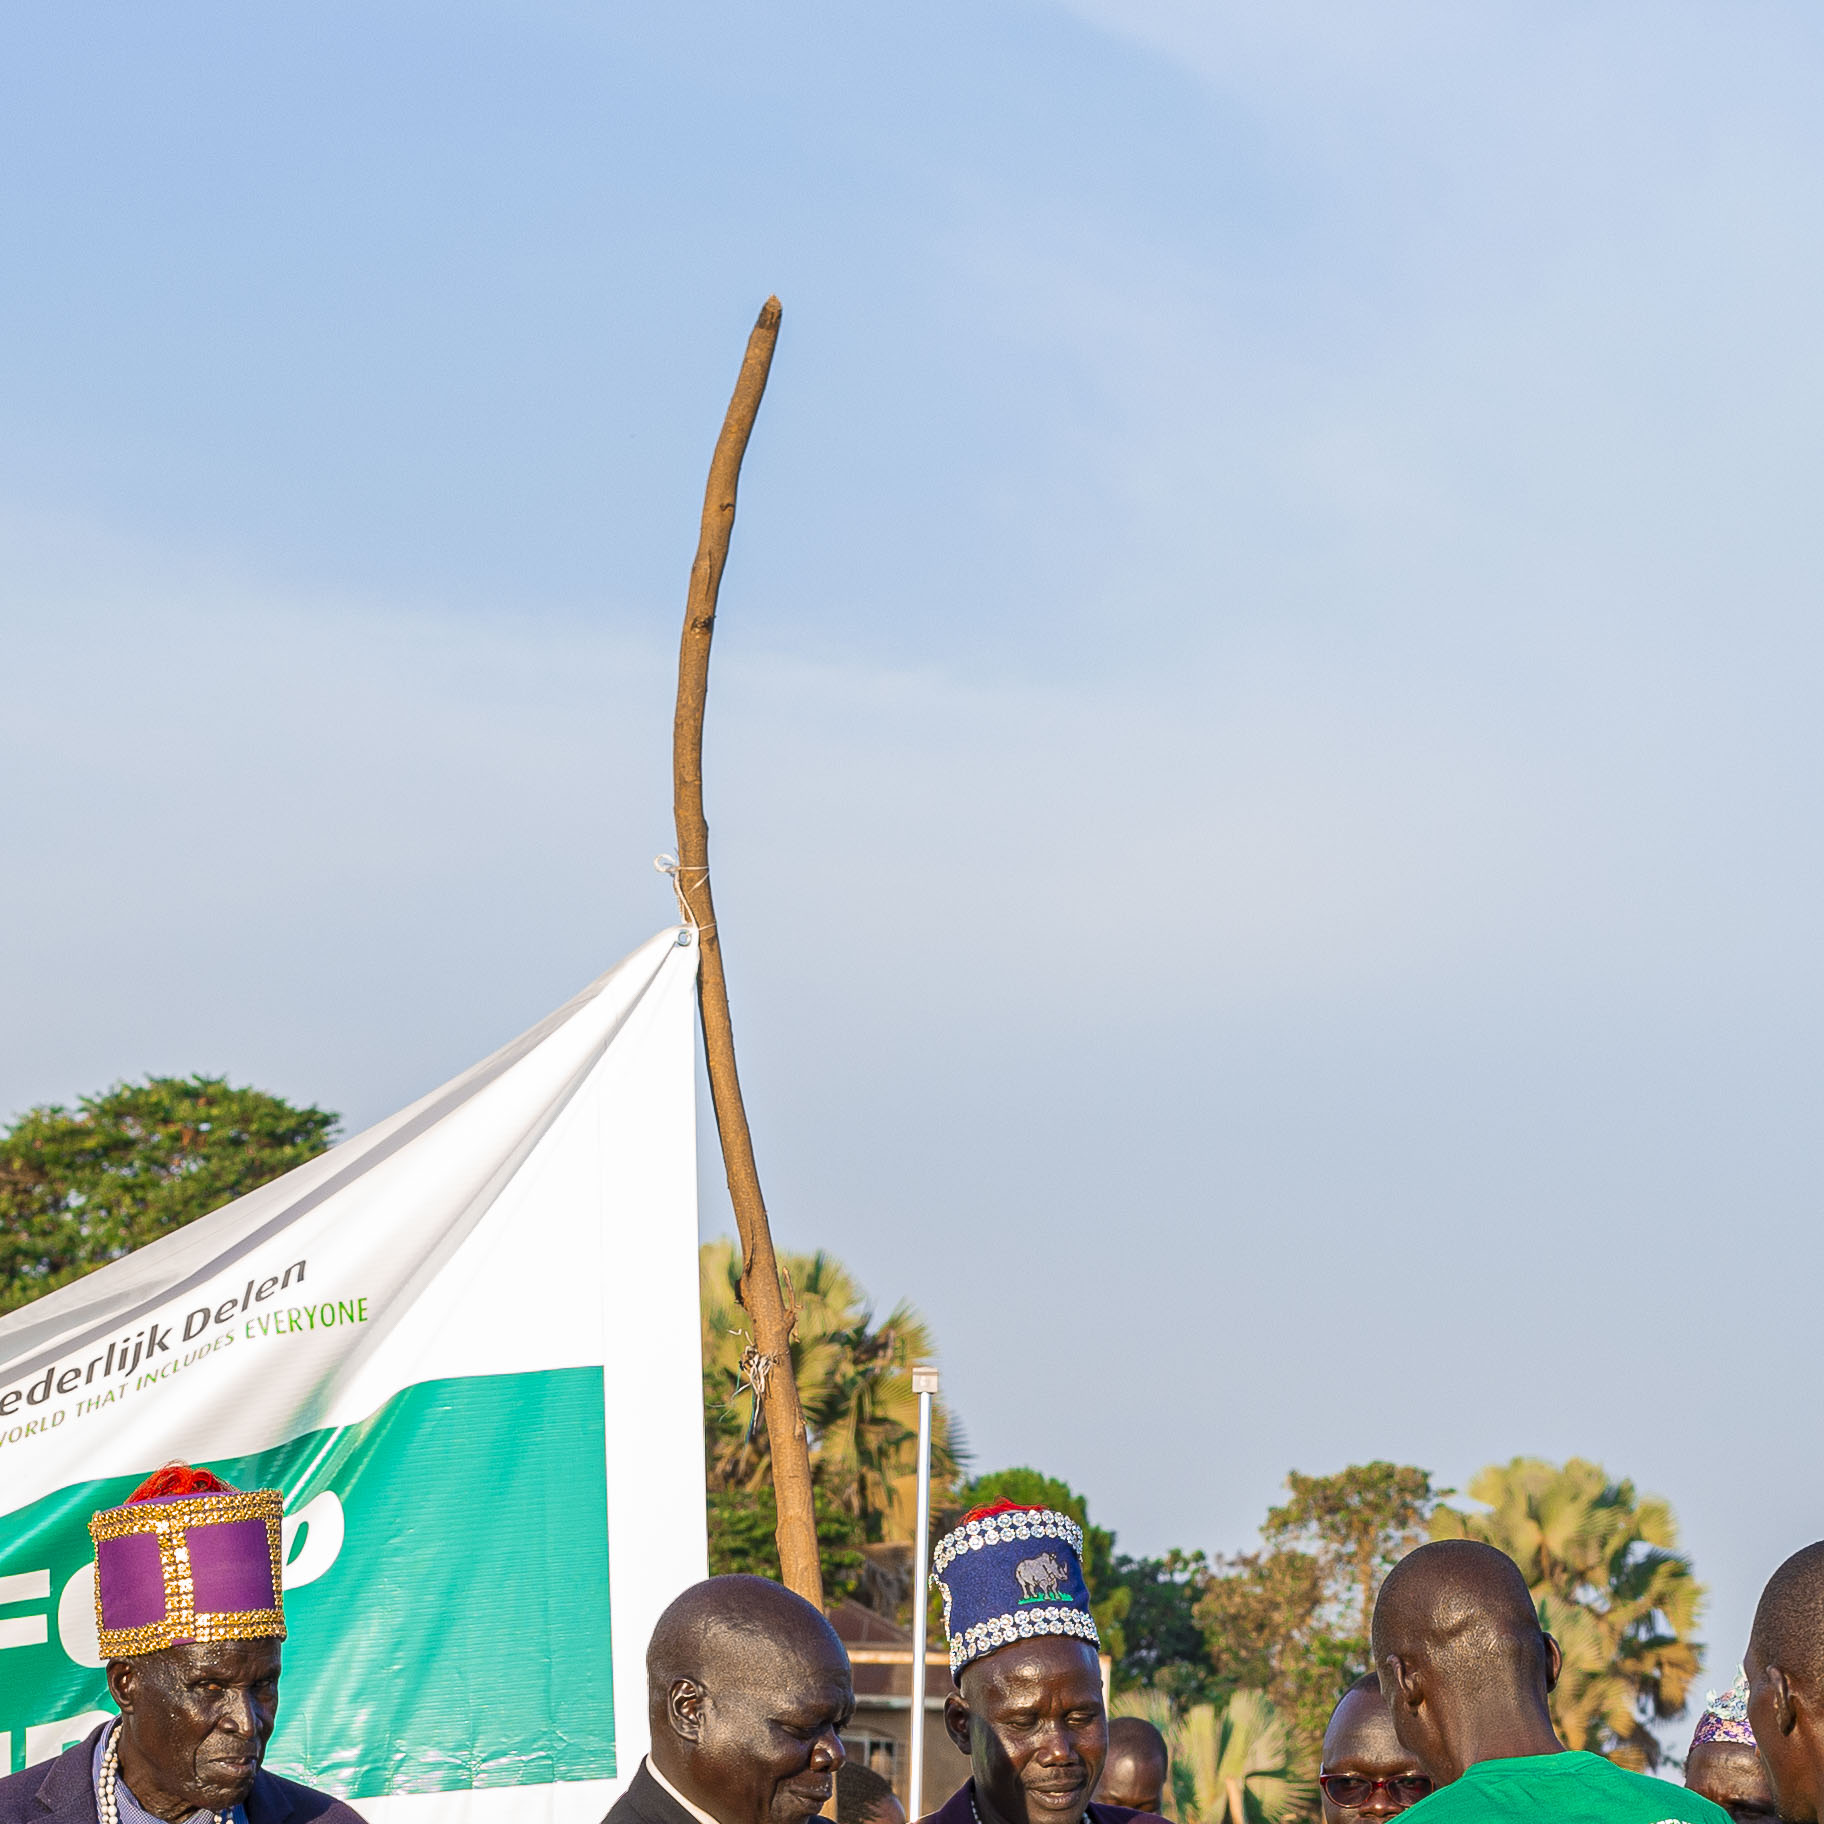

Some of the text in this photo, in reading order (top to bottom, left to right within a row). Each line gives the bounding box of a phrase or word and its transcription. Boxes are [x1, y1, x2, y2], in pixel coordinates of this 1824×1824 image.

[182, 1259, 308, 1344] Delen
[76, 1383, 129, 1419] THAT
[136, 1333, 235, 1391] INCLUDES
[245, 1297, 369, 1340] EVERYONE
